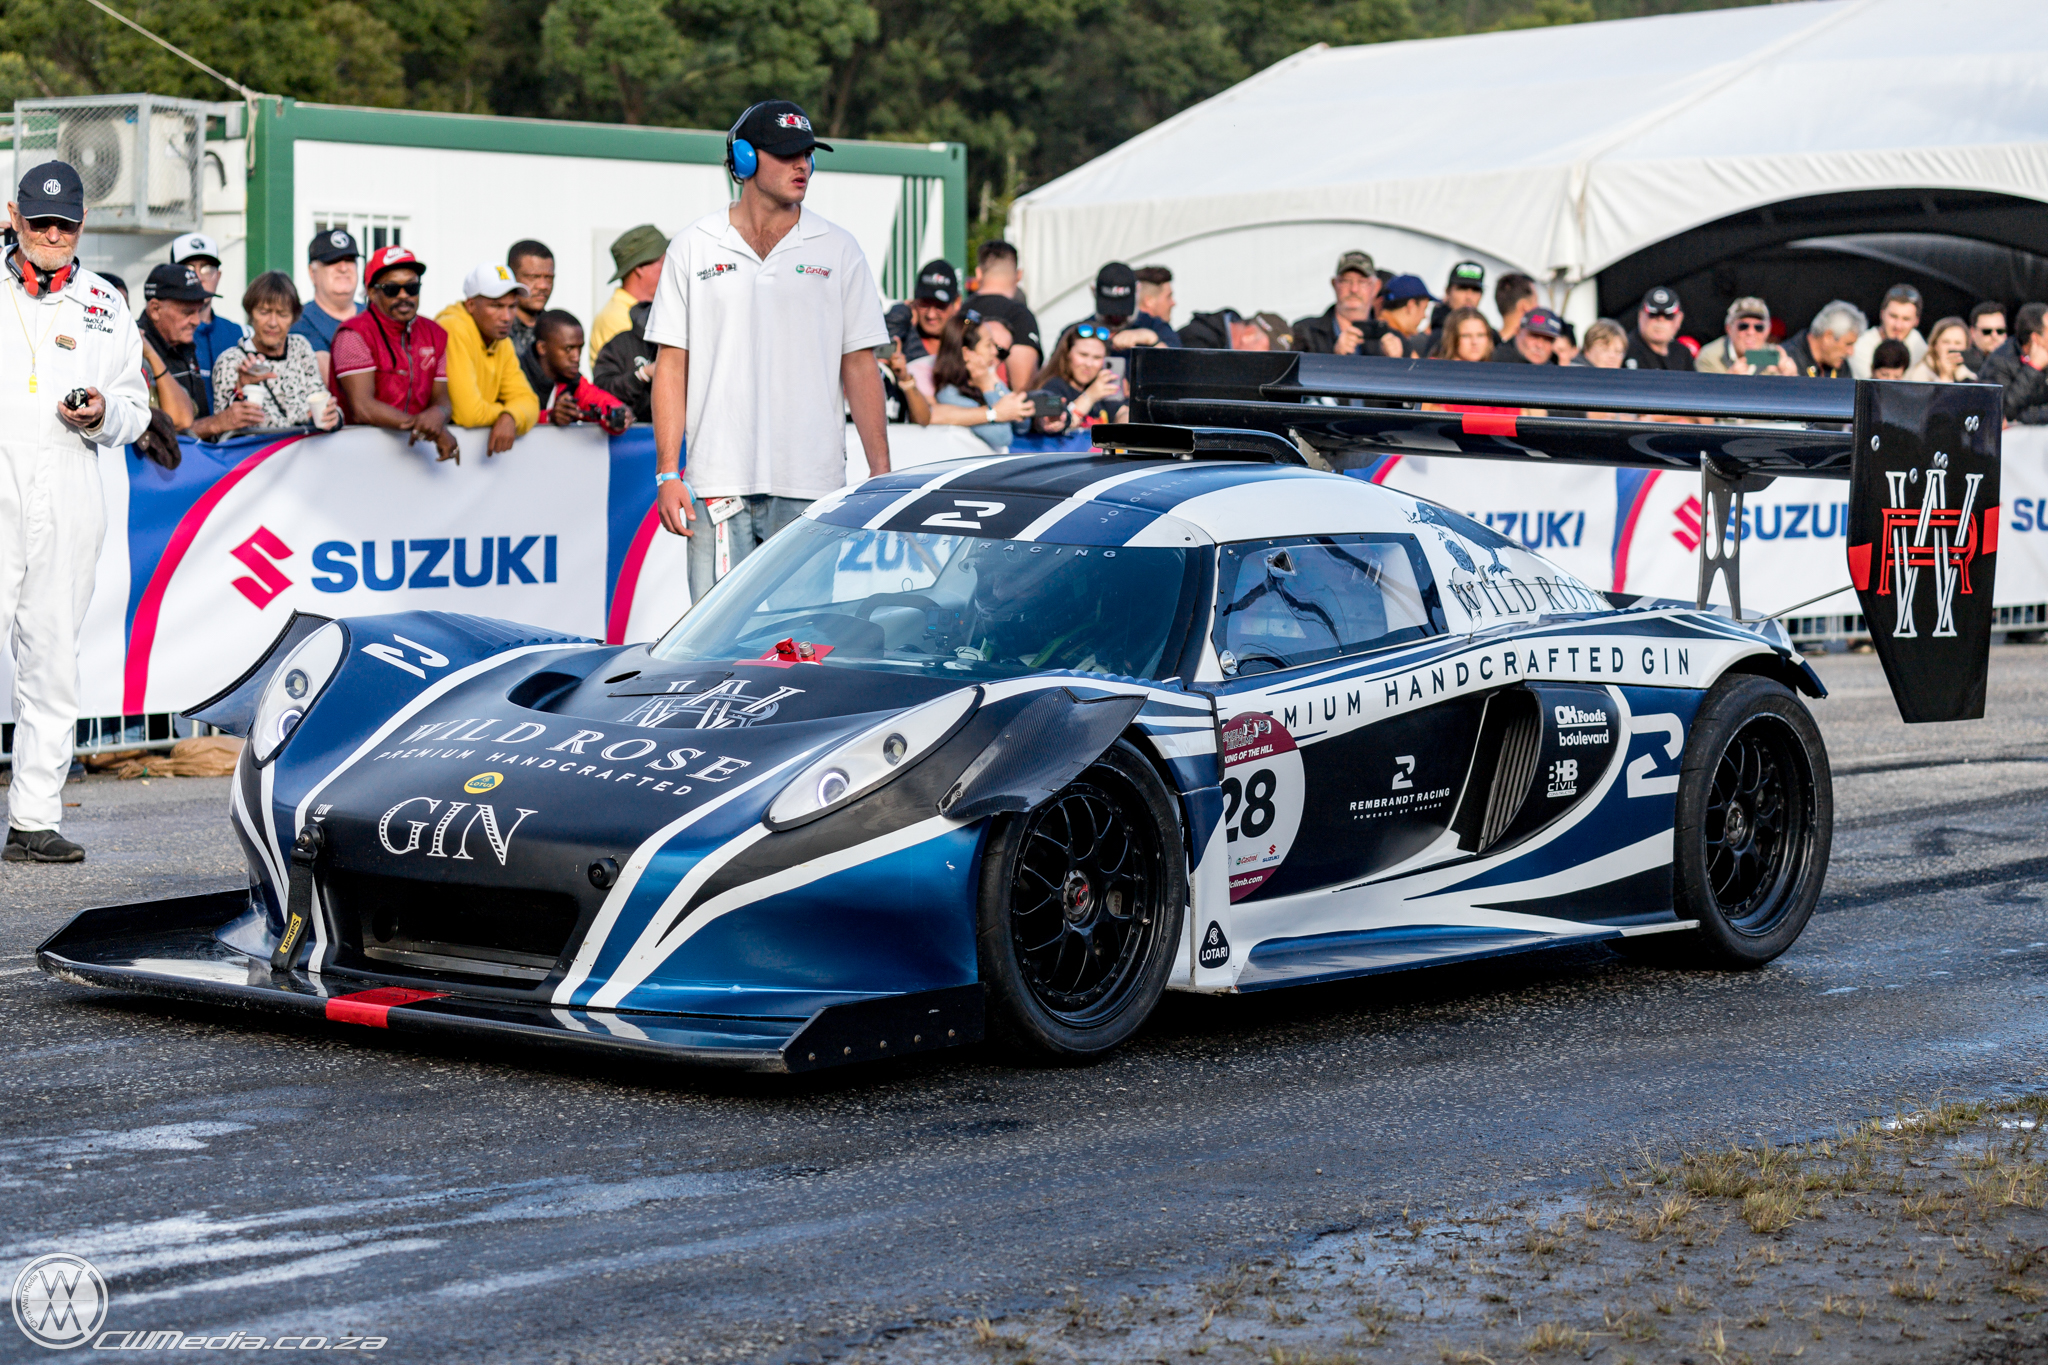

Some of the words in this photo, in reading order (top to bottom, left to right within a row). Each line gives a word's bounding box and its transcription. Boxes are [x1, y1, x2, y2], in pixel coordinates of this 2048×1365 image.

[46, 180, 60, 194] MG
[806, 266, 830, 277] Castrol
[978, 541, 1117, 558] RACING
[311, 534, 558, 593] SUZUKI
[1447, 577, 1537, 622] WILD
[1385, 647, 1624, 708] HANDCRAFTED
[1642, 647, 1690, 676] GIN
[399, 717, 547, 745] WILD
[546, 729, 753, 783] ROSE
[1238, 750, 1248, 760] OF
[1248, 746, 1261, 758] THE
[1260, 744, 1274, 755] HILL
[374, 746, 478, 761] PREMIUM
[486, 752, 694, 796] HANDCRAFTED
[1547, 781, 1578, 792] CIVIL
[1220, 768, 1277, 843] 28
[1349, 794, 1415, 811] REMBRANDT
[1416, 787, 1451, 802] RACING
[314, 803, 334, 815] TOW
[1354, 811, 1393, 820] POWERED
[1414, 803, 1442, 812] DREAMS
[378, 796, 539, 866] GIN
[1241, 853, 1258, 864] Castrol
[1201, 946, 1228, 961] LOTARI
